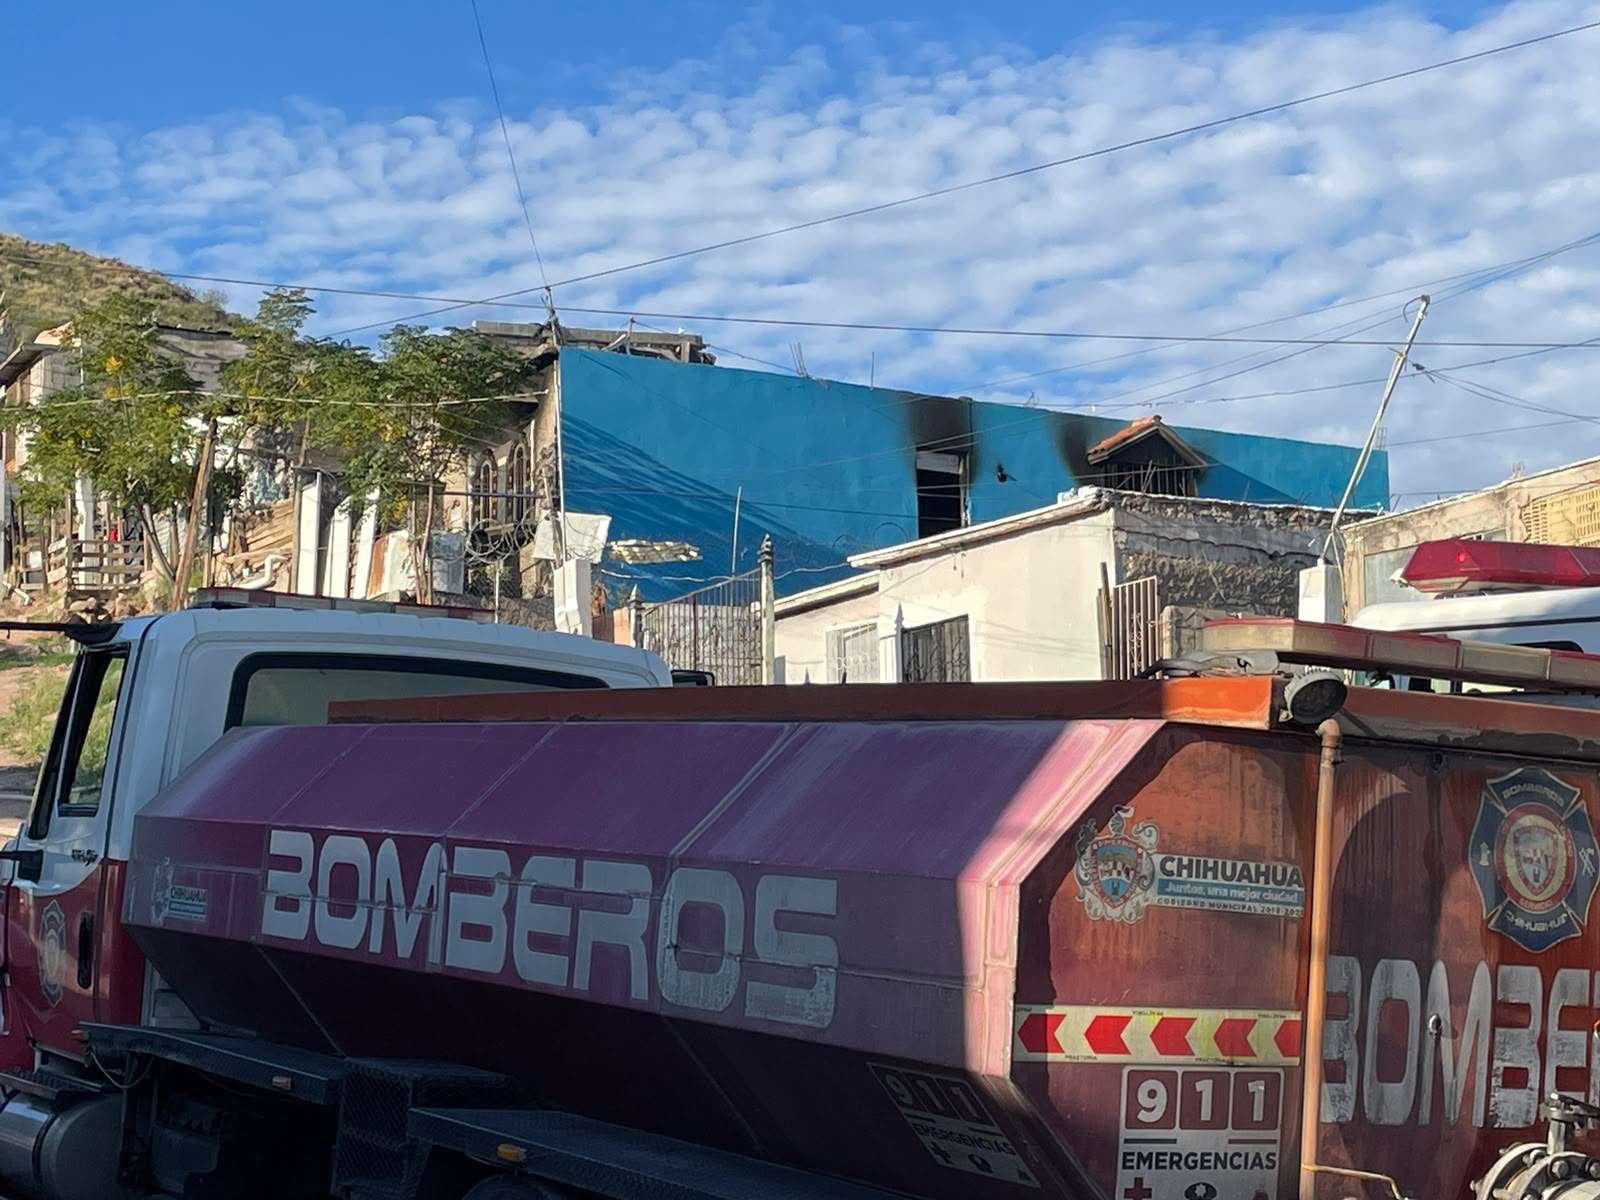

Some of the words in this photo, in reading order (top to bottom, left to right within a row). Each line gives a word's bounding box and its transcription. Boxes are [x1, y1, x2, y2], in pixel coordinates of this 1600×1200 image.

[1160, 855, 1304, 888] CHIHUAHUA
[261, 830, 840, 1029] BOMBEROS
[1321, 955, 1600, 1129] BOMBE
[1136, 1079, 1266, 1123] 911
[1121, 1151, 1277, 1171] EMERGENCIAS
